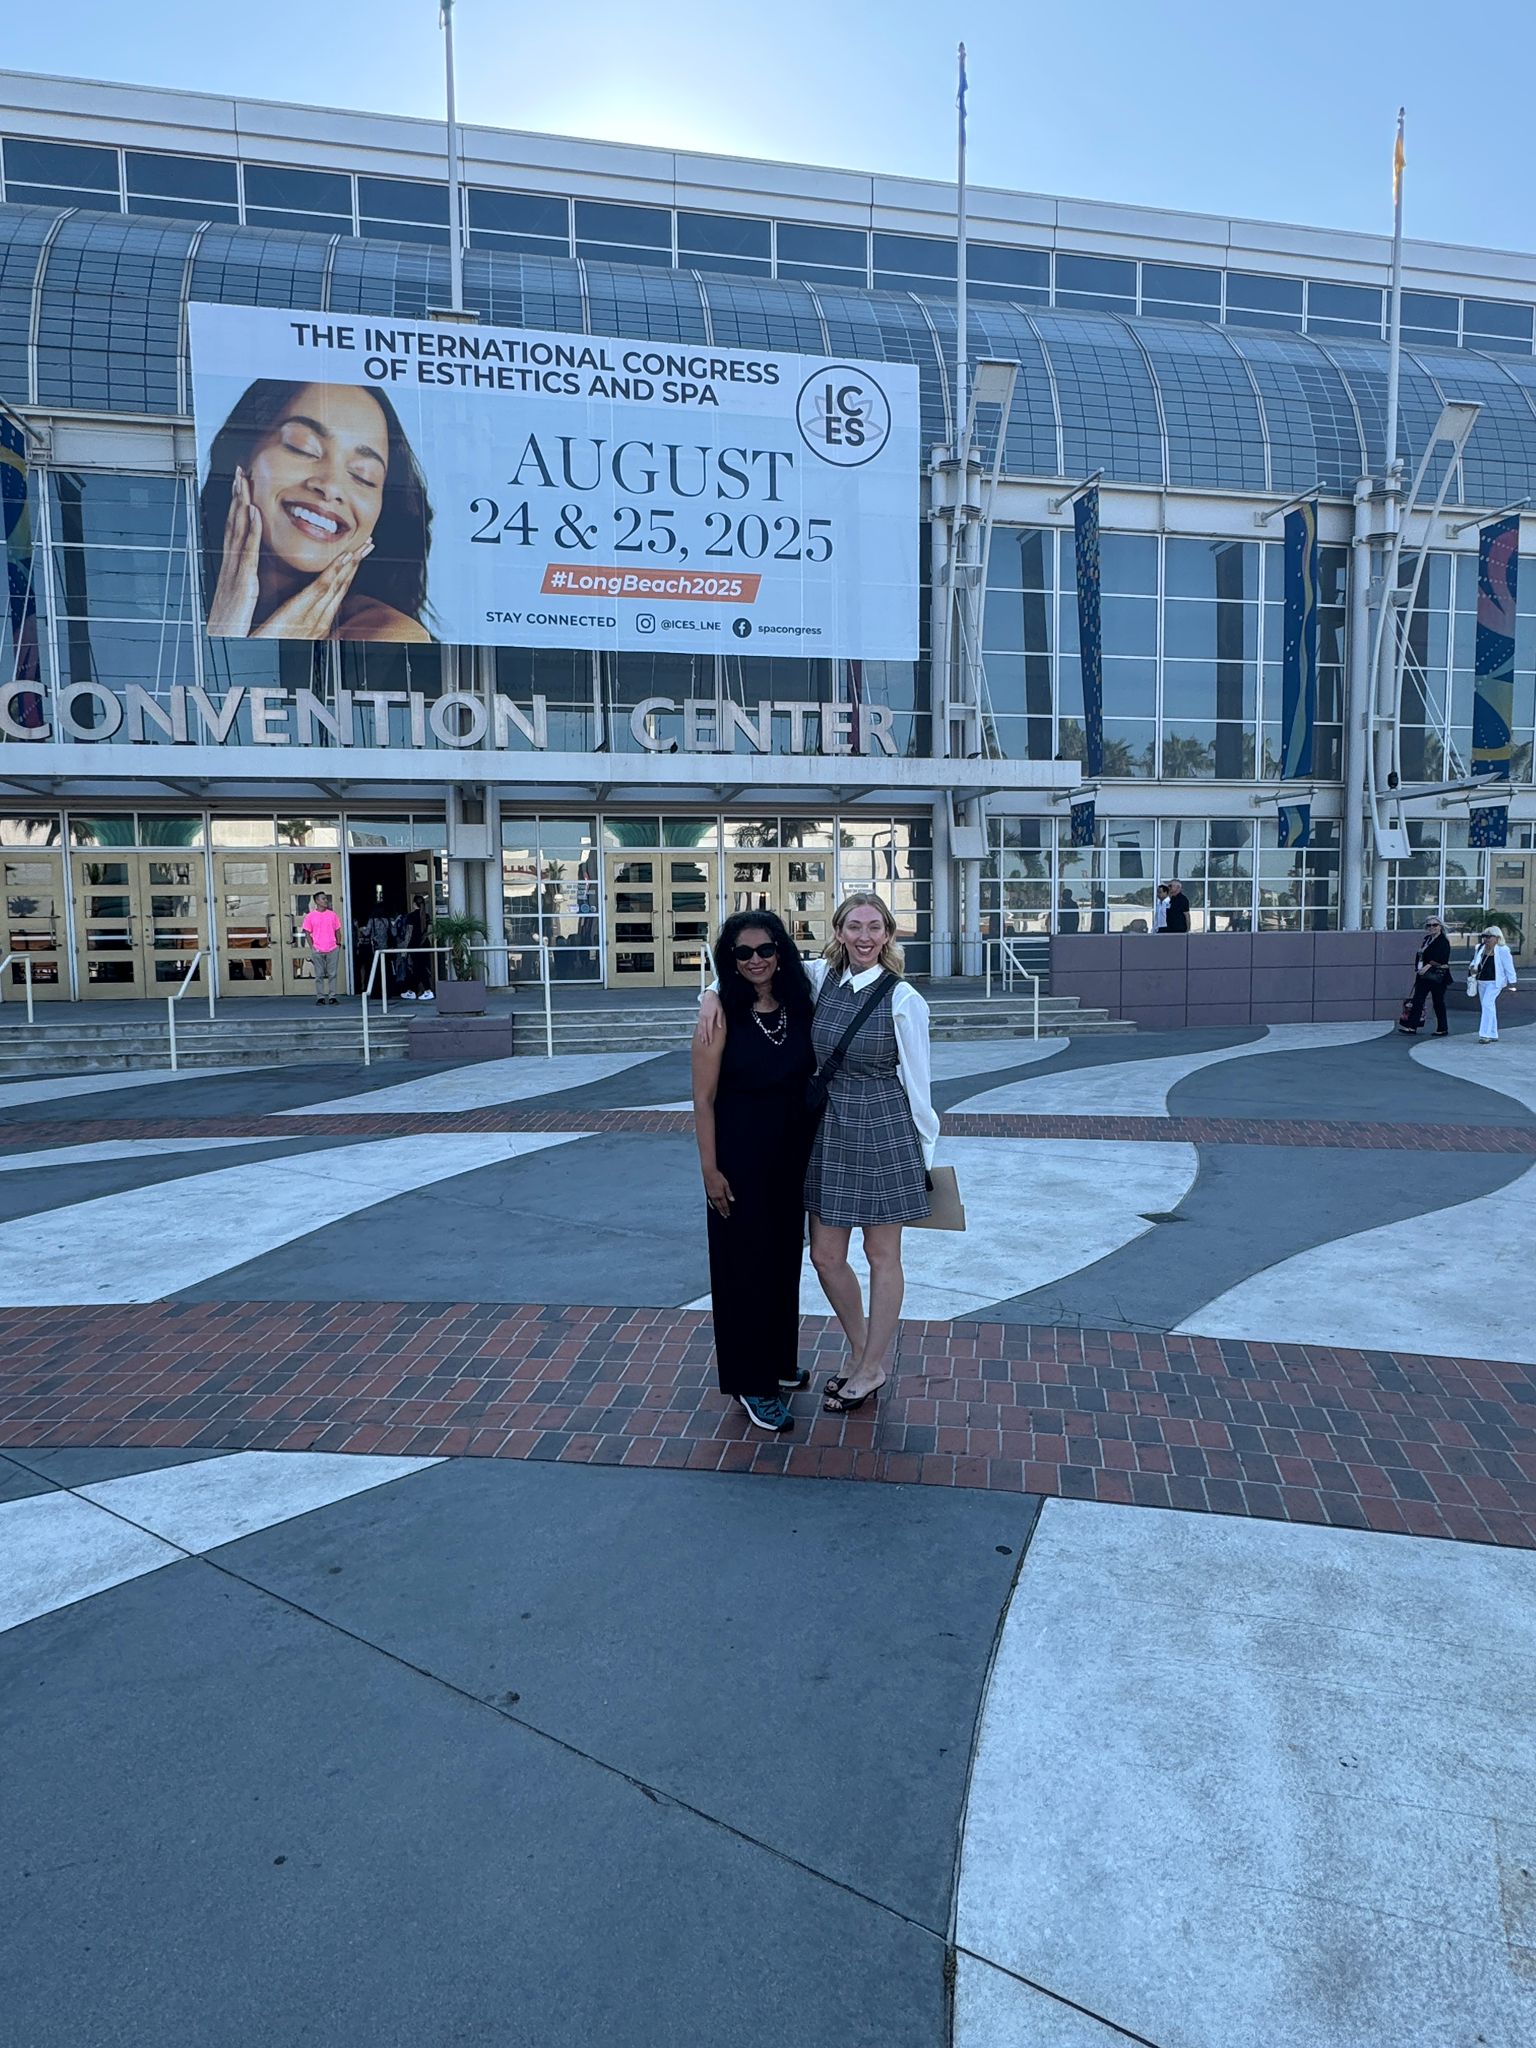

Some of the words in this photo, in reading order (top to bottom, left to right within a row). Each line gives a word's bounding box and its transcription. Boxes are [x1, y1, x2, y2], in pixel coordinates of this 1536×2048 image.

[290, 322, 355, 349] THE
[365, 328, 616, 373] INTERNATIONAL
[622, 351, 780, 386] CONGRESS
[364, 357, 408, 382] OF
[418, 360, 581, 395] ESTHETICS
[588, 375, 654, 401] AND
[662, 381, 720, 406] SPA
[825, 384, 864, 416] IC
[825, 417, 866, 447] ES
[507, 432, 794, 502] AUGUST
[469, 497, 539, 547] 24
[554, 503, 599, 551] &
[613, 506, 689, 563] 25,
[704, 511, 834, 563] 2025
[550, 570, 743, 597] #LongBeach2025
[485, 610, 522, 624] STAY
[526, 613, 617, 629] CONNECTED
[660, 619, 722, 632] @ICES_LNE
[757, 624, 823, 637] spacongress
[0, 679, 547, 749] CONVENTION
[630, 696, 899, 755] CENTER
